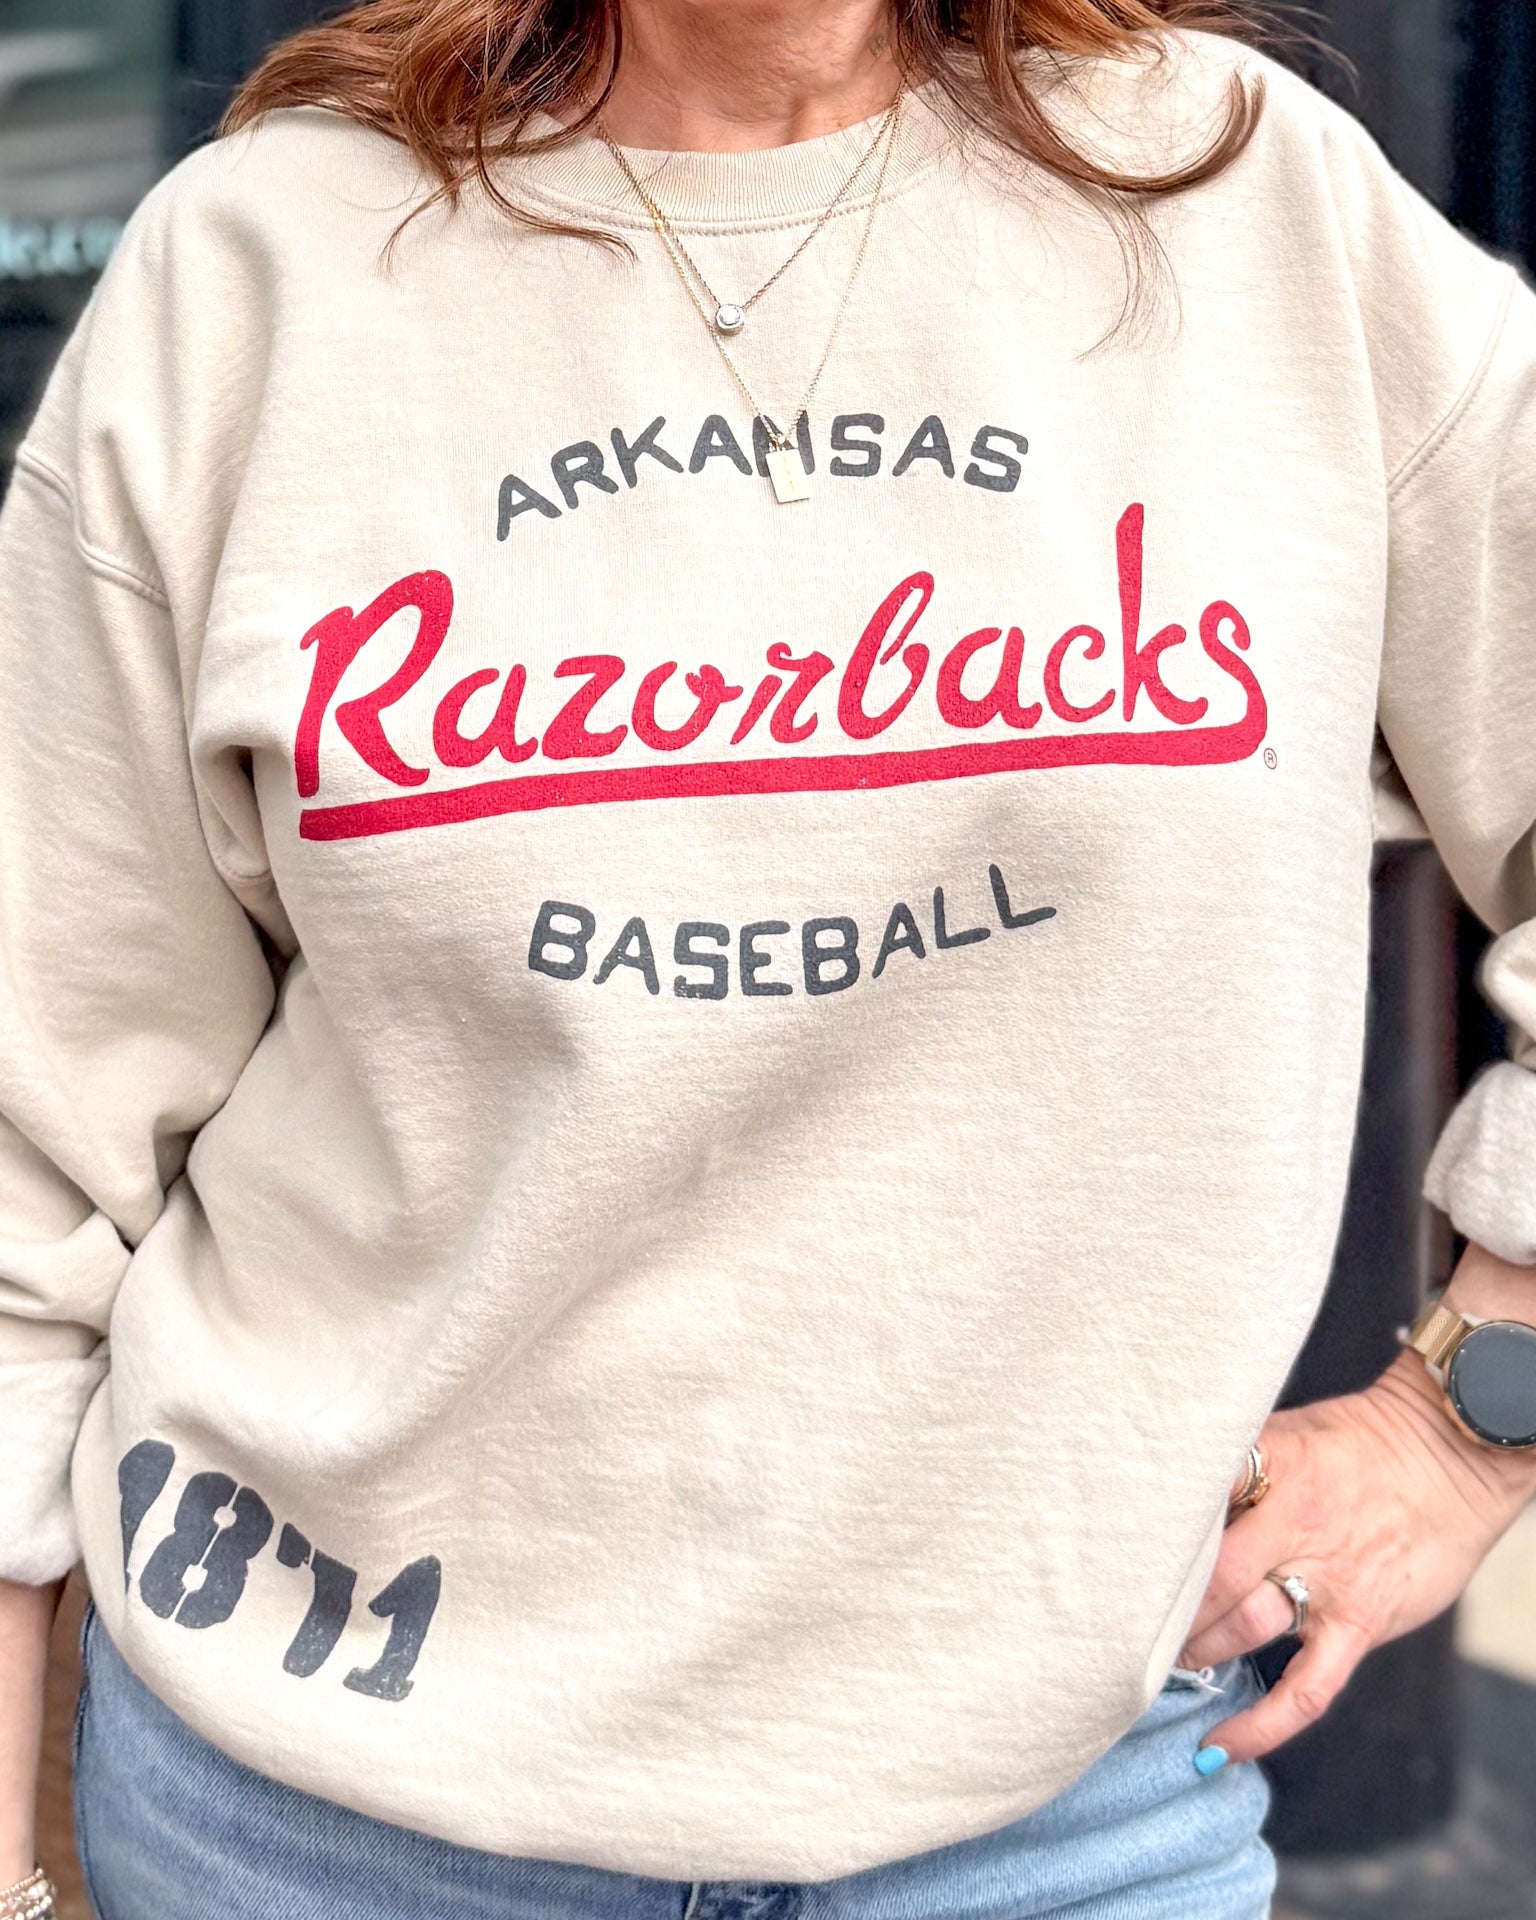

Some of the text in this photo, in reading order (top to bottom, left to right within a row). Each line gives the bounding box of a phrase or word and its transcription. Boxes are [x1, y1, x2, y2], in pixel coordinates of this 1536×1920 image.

[496, 412, 1029, 541] ARKANSAS
[296, 502, 1268, 797] Razorbacks
[529, 863, 1057, 1000] BASEBALL
